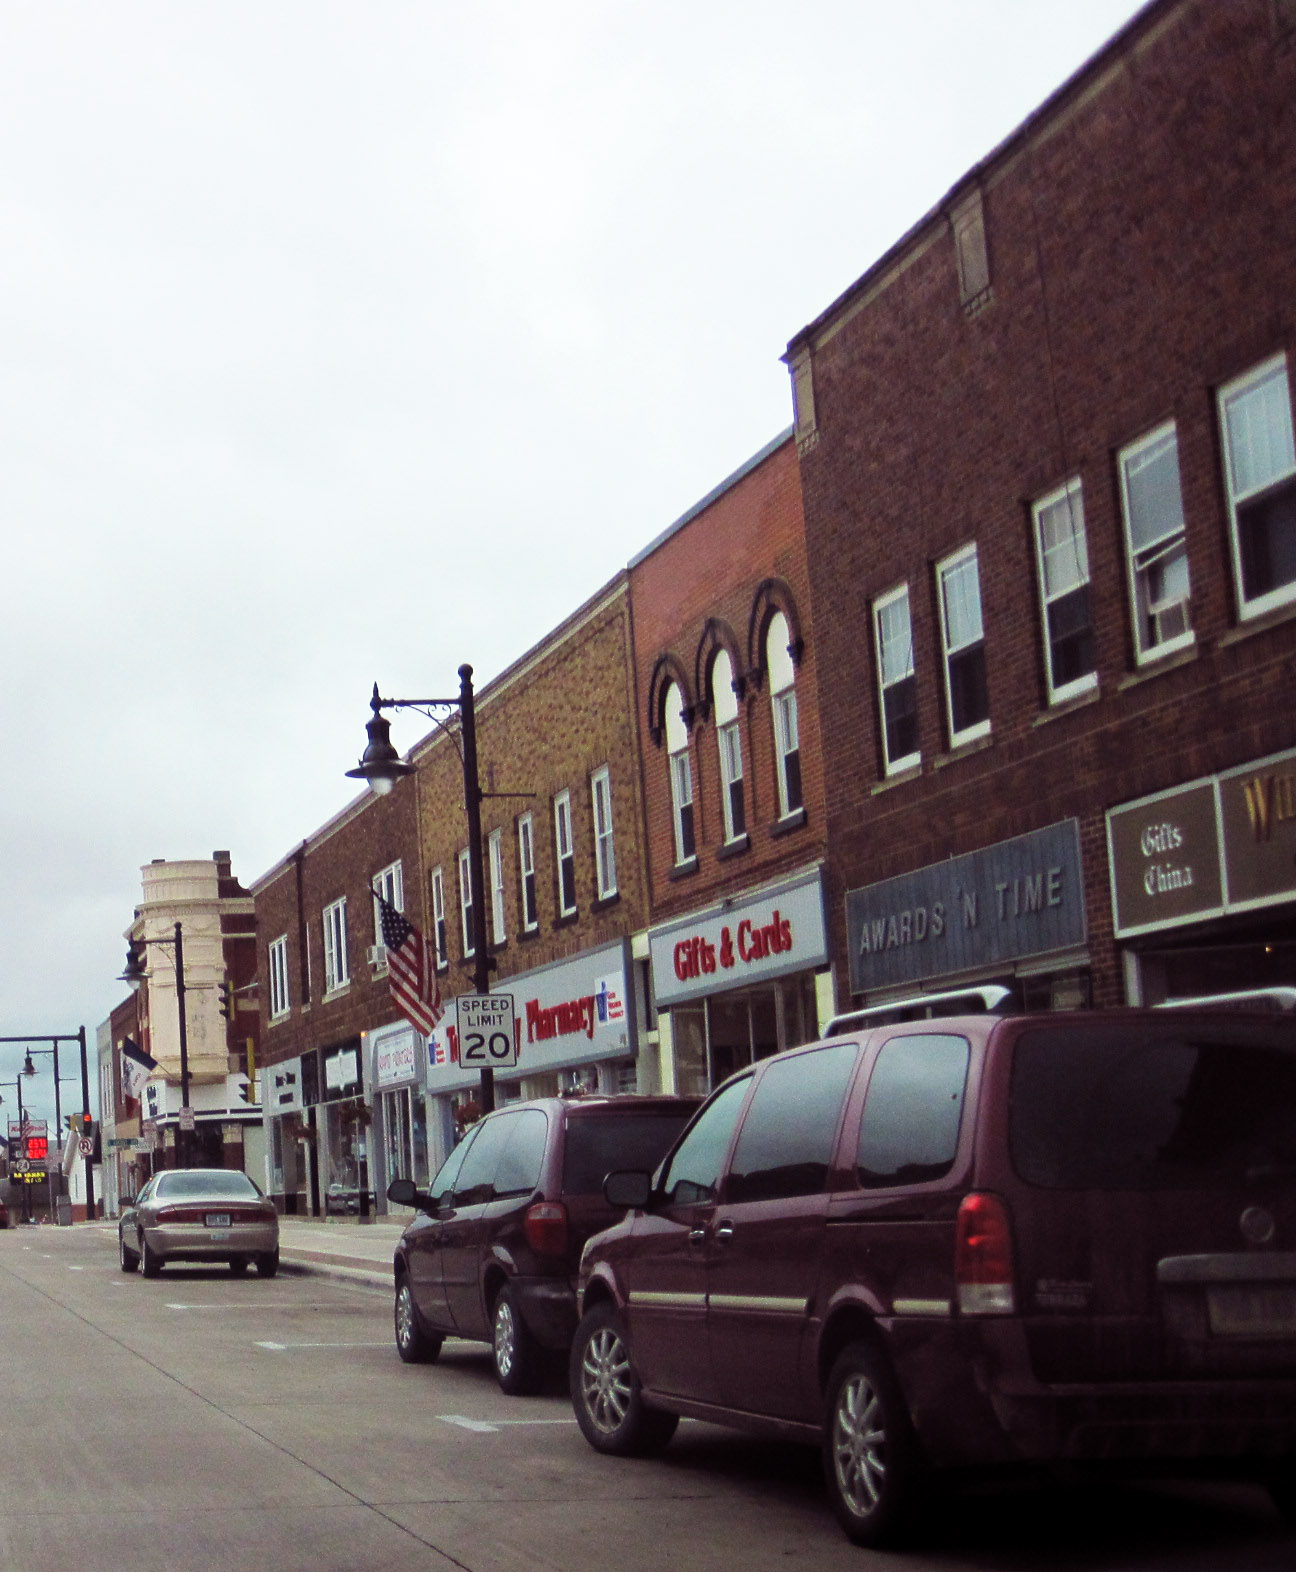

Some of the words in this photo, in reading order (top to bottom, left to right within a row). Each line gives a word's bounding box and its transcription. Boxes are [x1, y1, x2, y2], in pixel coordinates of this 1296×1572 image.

[1140, 823, 1182, 857] Gifts
[1144, 863, 1193, 896] China
[859, 902, 945, 954] AWARDS
[995, 866, 1061, 919] TIME
[674, 936, 716, 981] Gifts
[720, 926, 735, 968] &
[737, 910, 792, 963] Cards
[462, 999, 509, 1012] SPEED
[467, 1014, 504, 1027] LIMIT
[525, 995, 596, 1043] Pharmacy
[465, 1032, 510, 1059] 20
